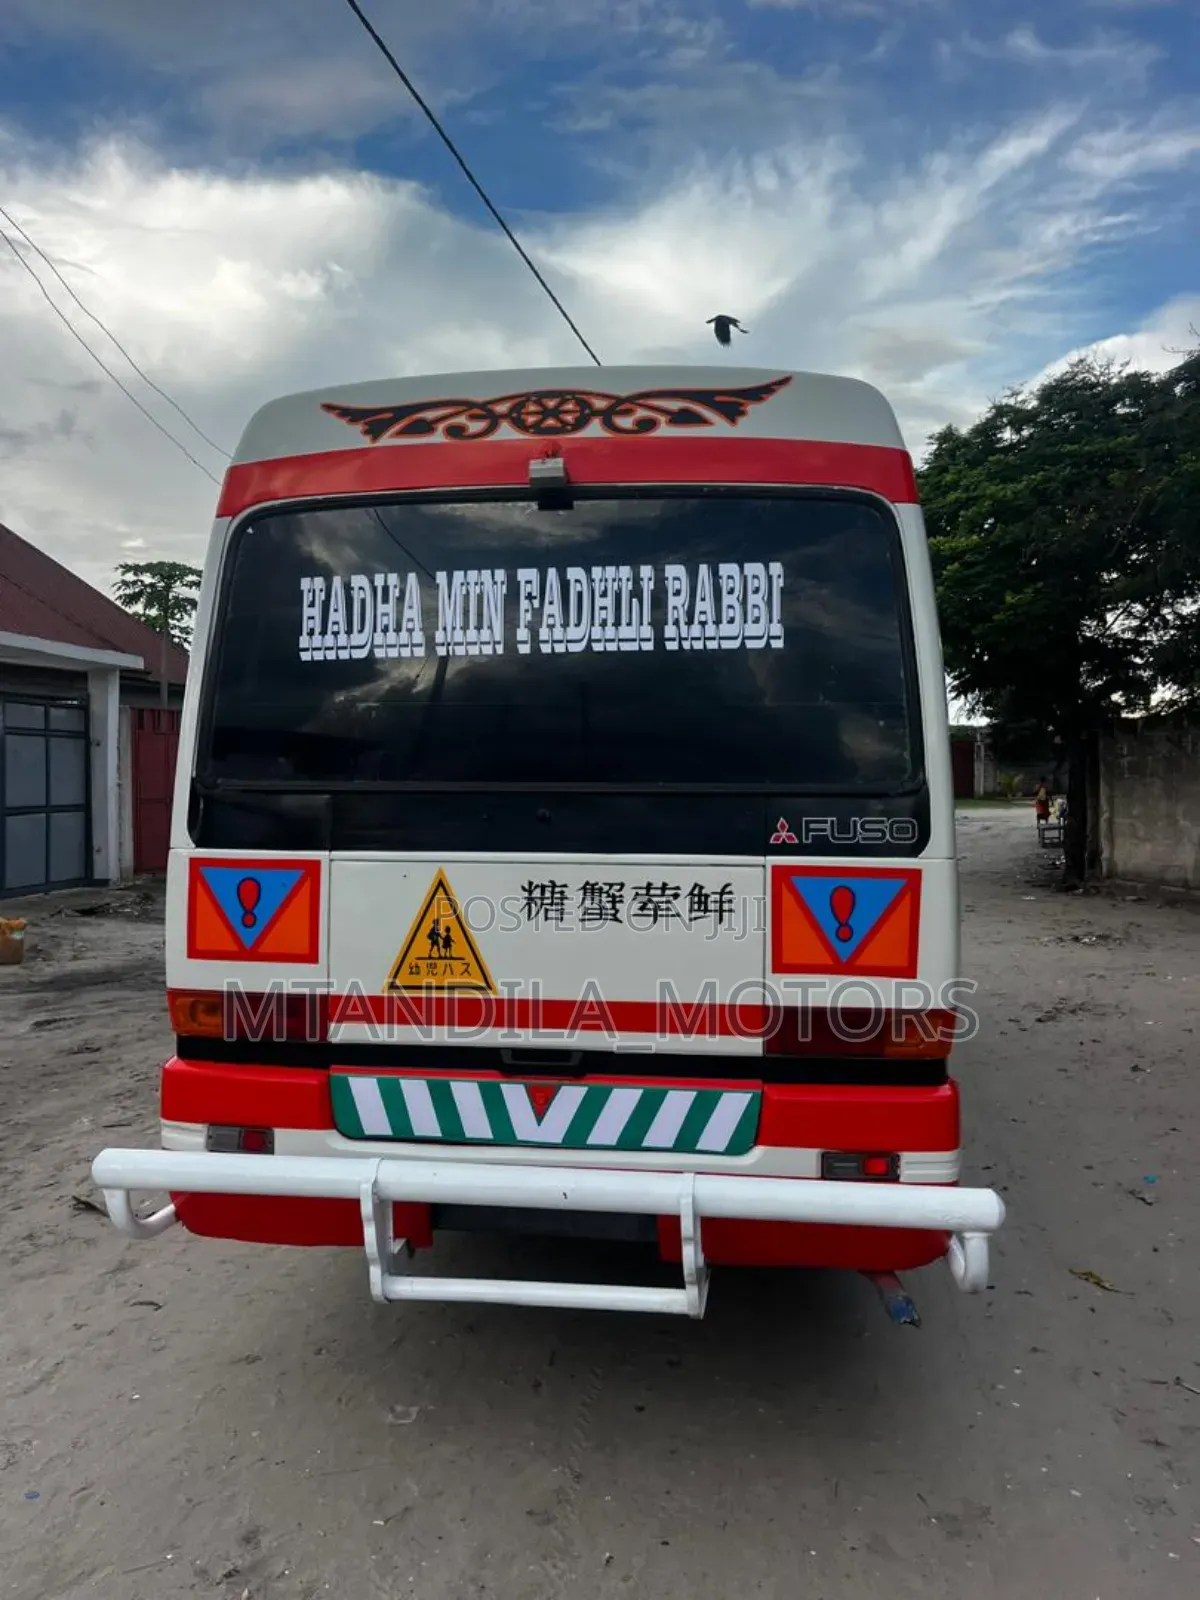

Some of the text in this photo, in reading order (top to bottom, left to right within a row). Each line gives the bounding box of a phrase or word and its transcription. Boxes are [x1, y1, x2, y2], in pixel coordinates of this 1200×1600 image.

[299, 562, 785, 662] HADHA MIN FADHLI RABBI
[802, 817, 918, 844] FUSO
